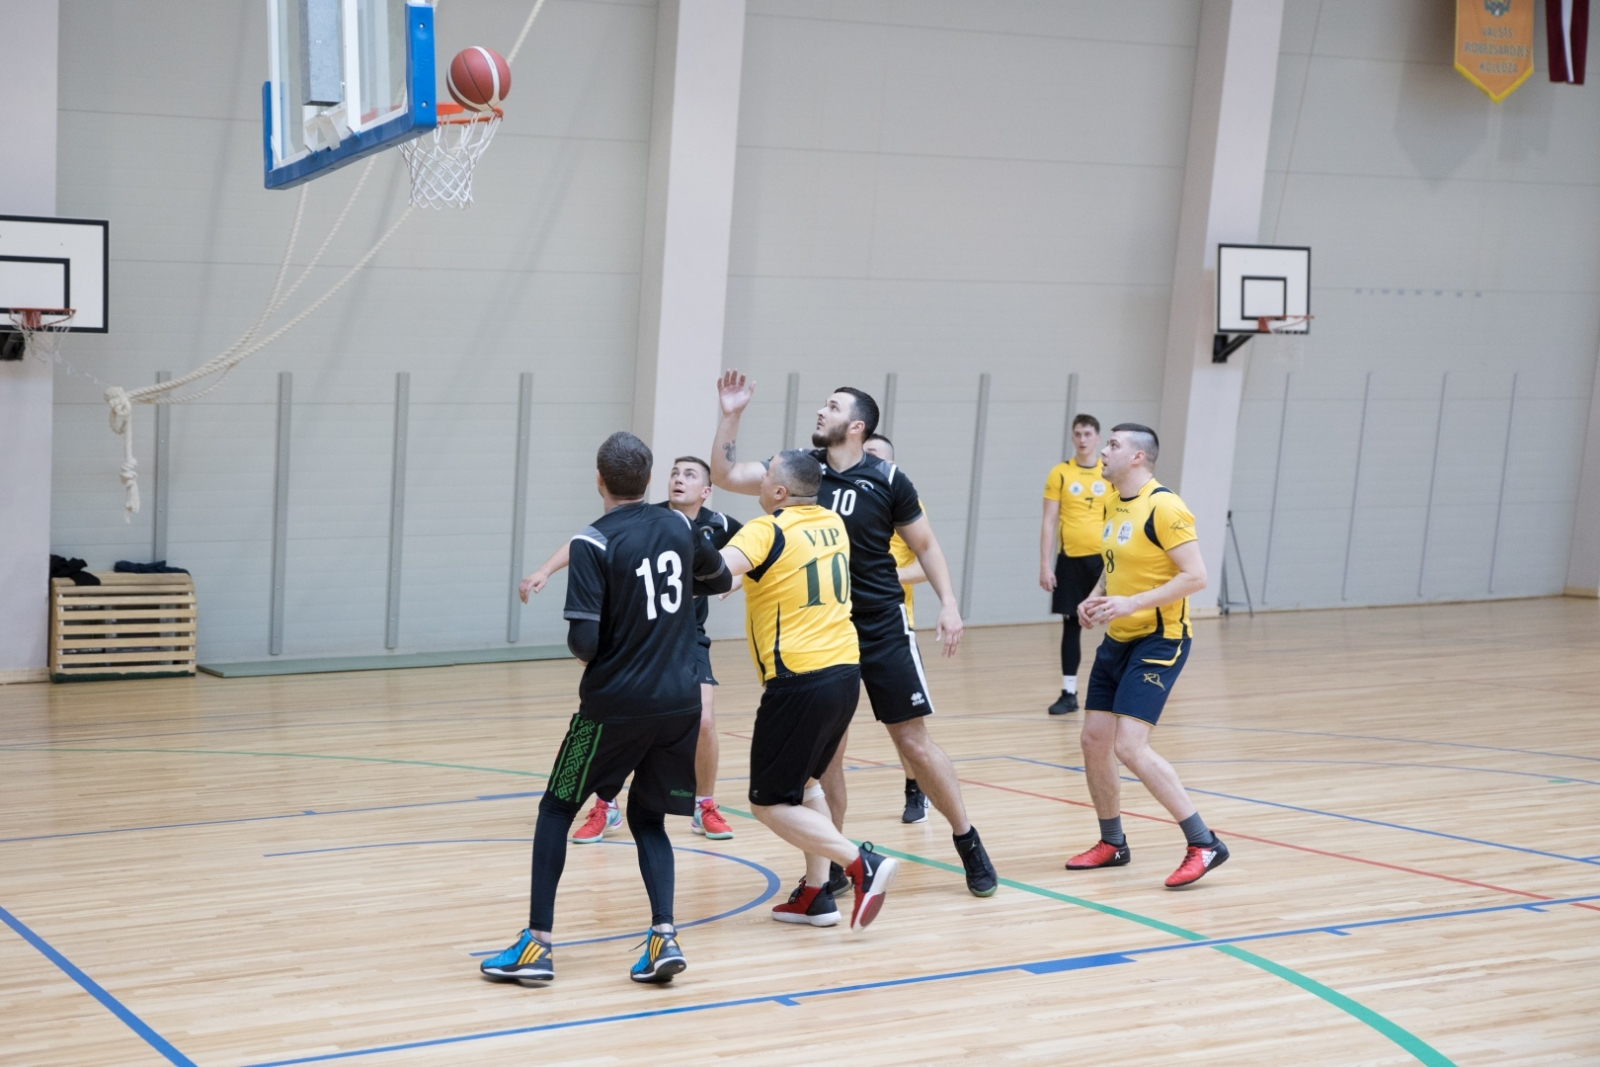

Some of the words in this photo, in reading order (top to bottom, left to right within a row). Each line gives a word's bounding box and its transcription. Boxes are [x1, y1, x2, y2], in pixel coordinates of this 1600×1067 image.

[831, 488, 857, 516] 10
[803, 528, 840, 547] VIP
[1105, 549, 1115, 573] 8
[635, 550, 683, 621] 13
[798, 552, 850, 609] 10
